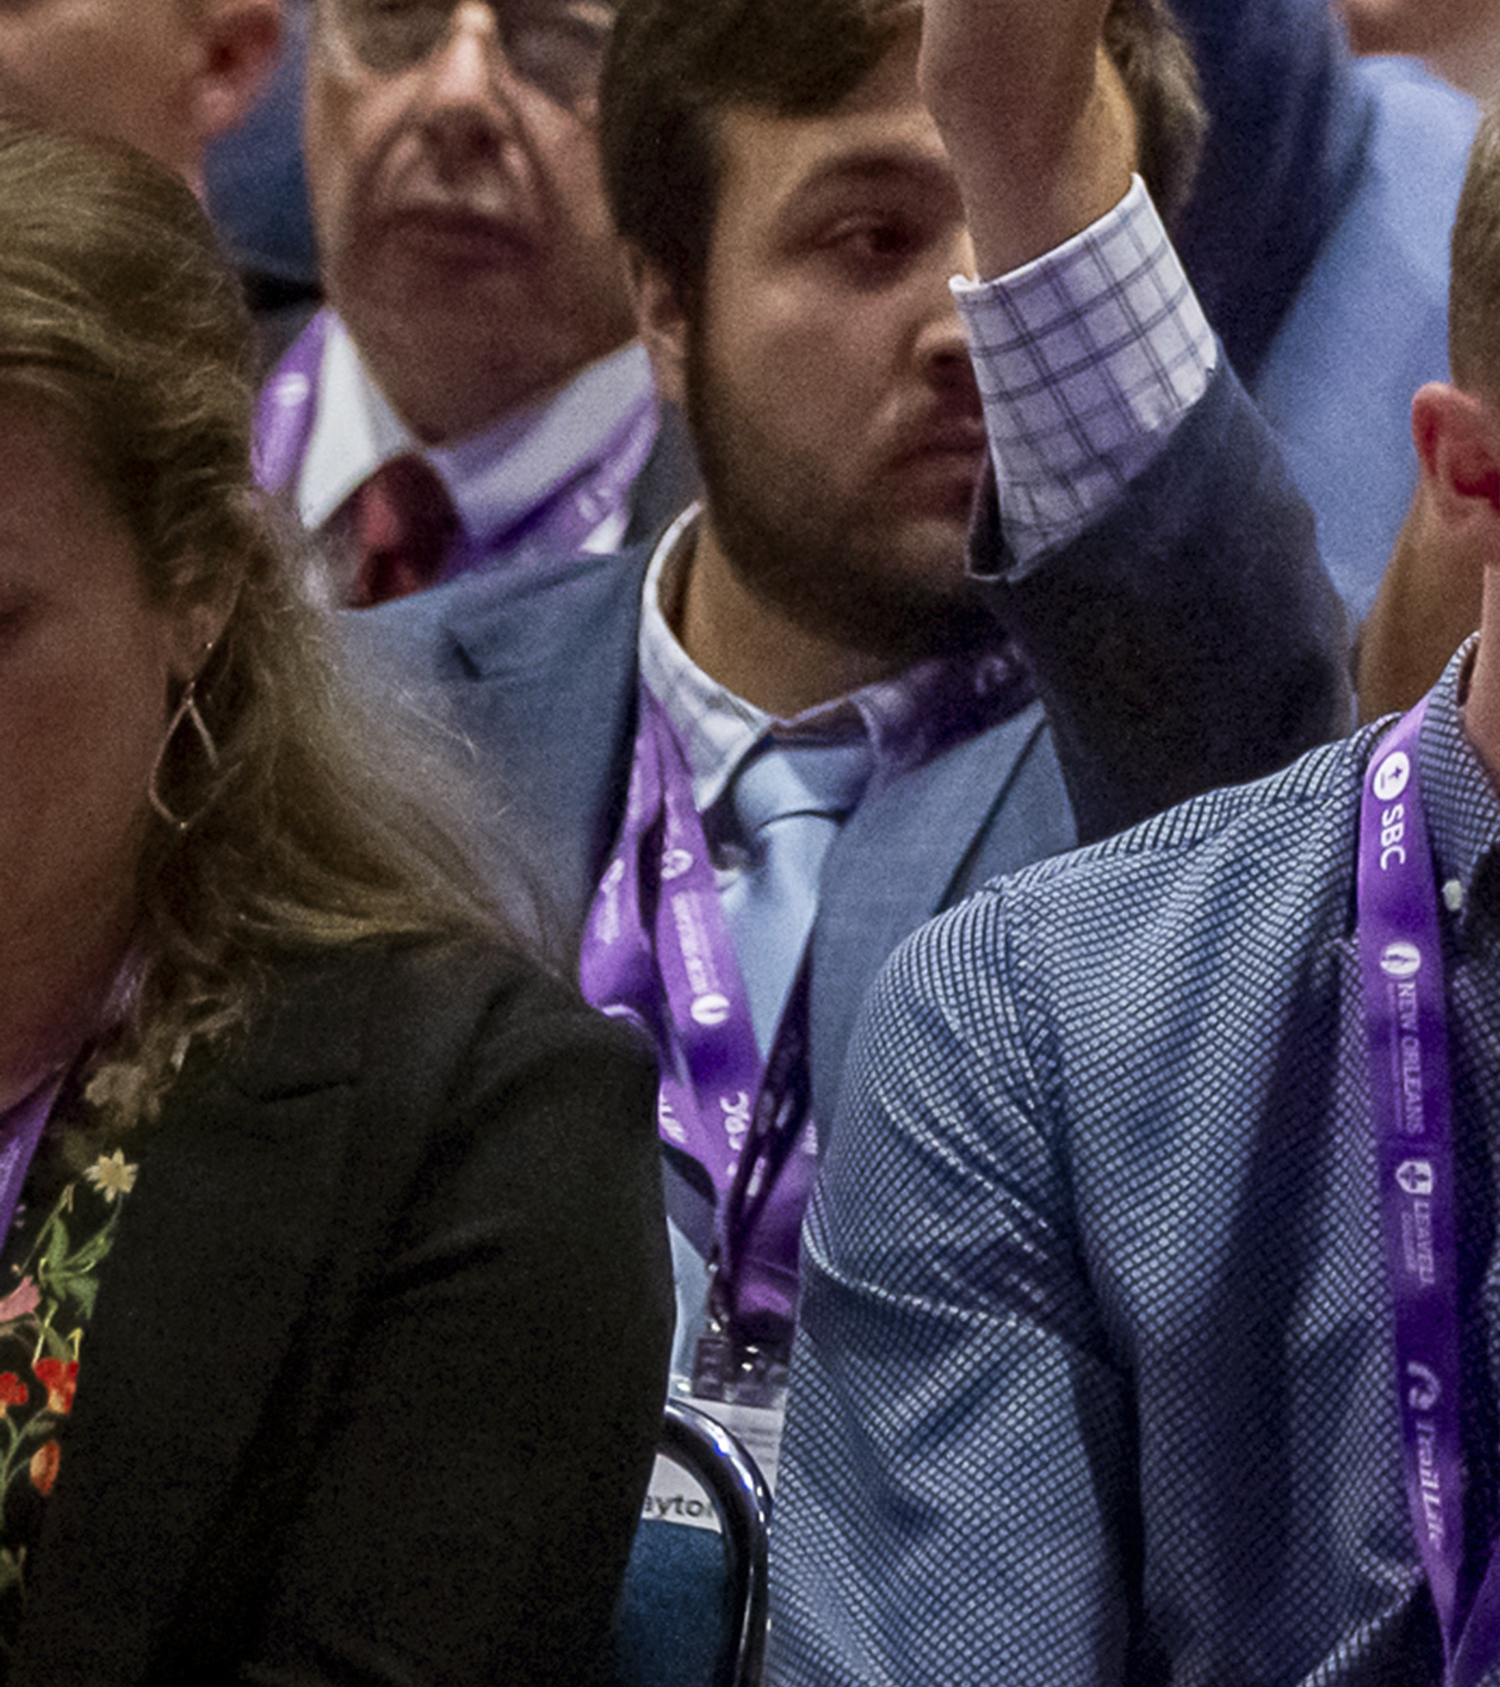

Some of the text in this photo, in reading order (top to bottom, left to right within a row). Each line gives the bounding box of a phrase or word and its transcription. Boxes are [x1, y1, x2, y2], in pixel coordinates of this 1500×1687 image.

[1381, 803, 1406, 870] SBC
[1398, 982, 1425, 1134] NEW ORLEANS
[645, 1495, 714, 1518] yto
